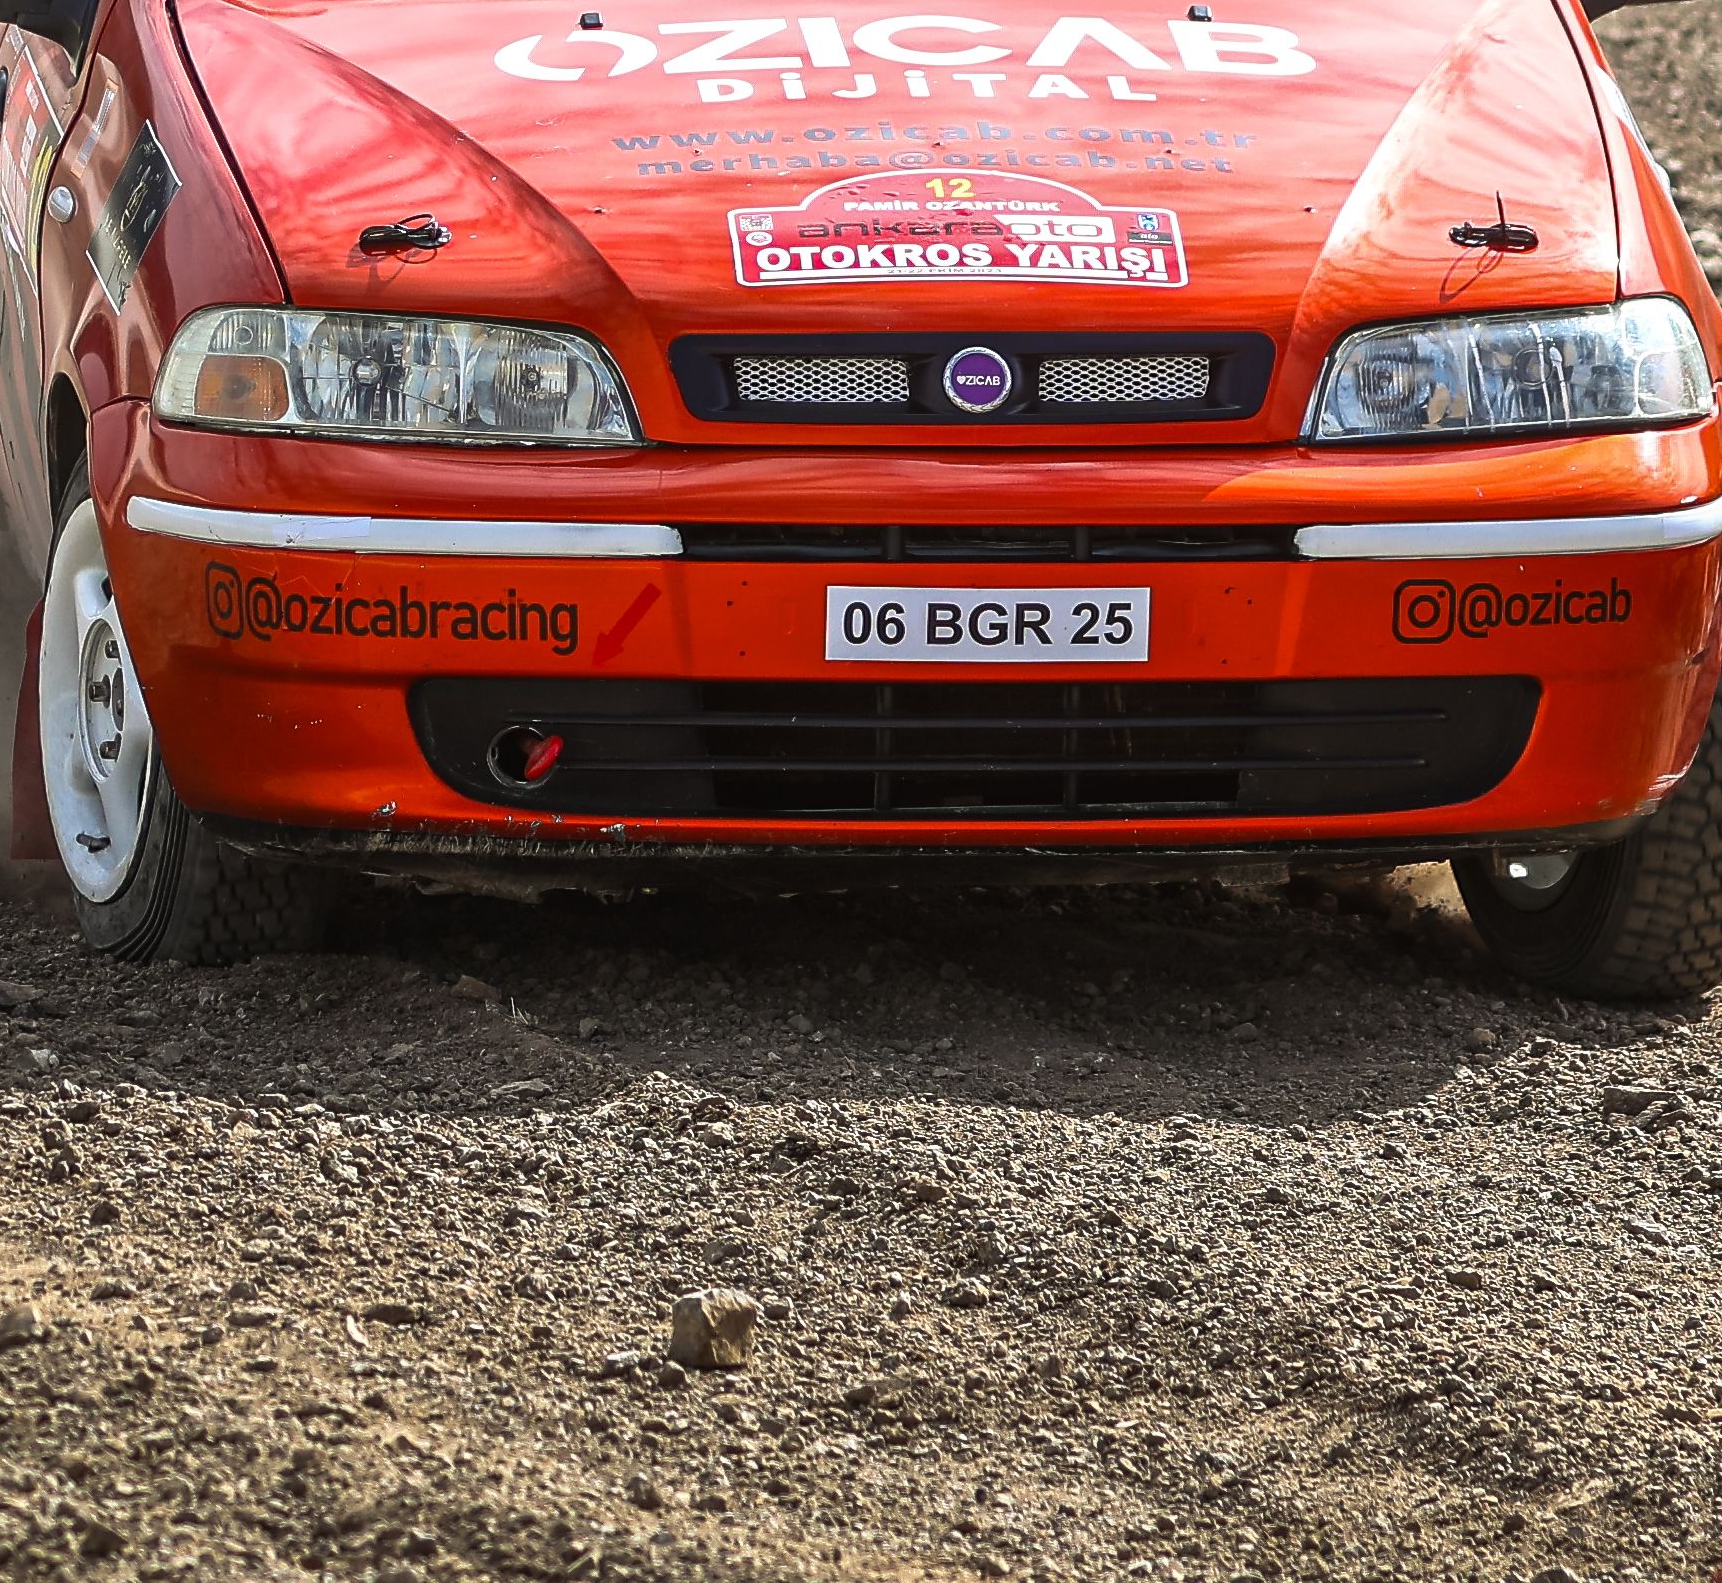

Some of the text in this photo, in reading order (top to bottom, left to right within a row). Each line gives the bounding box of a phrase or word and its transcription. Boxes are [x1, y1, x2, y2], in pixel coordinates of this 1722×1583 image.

[612, 120, 1258, 151] www.ozicab.com.tr
[637, 149, 1234, 176] merhaba@ozicab.net
[925, 177, 978, 199] 12
[755, 243, 1168, 278] OTOKROS YARIŞI
[245, 576, 579, 656] @ozicabracing
[842, 601, 1134, 645] 06 BGR 25
[1458, 576, 1632, 638] @ozicab
